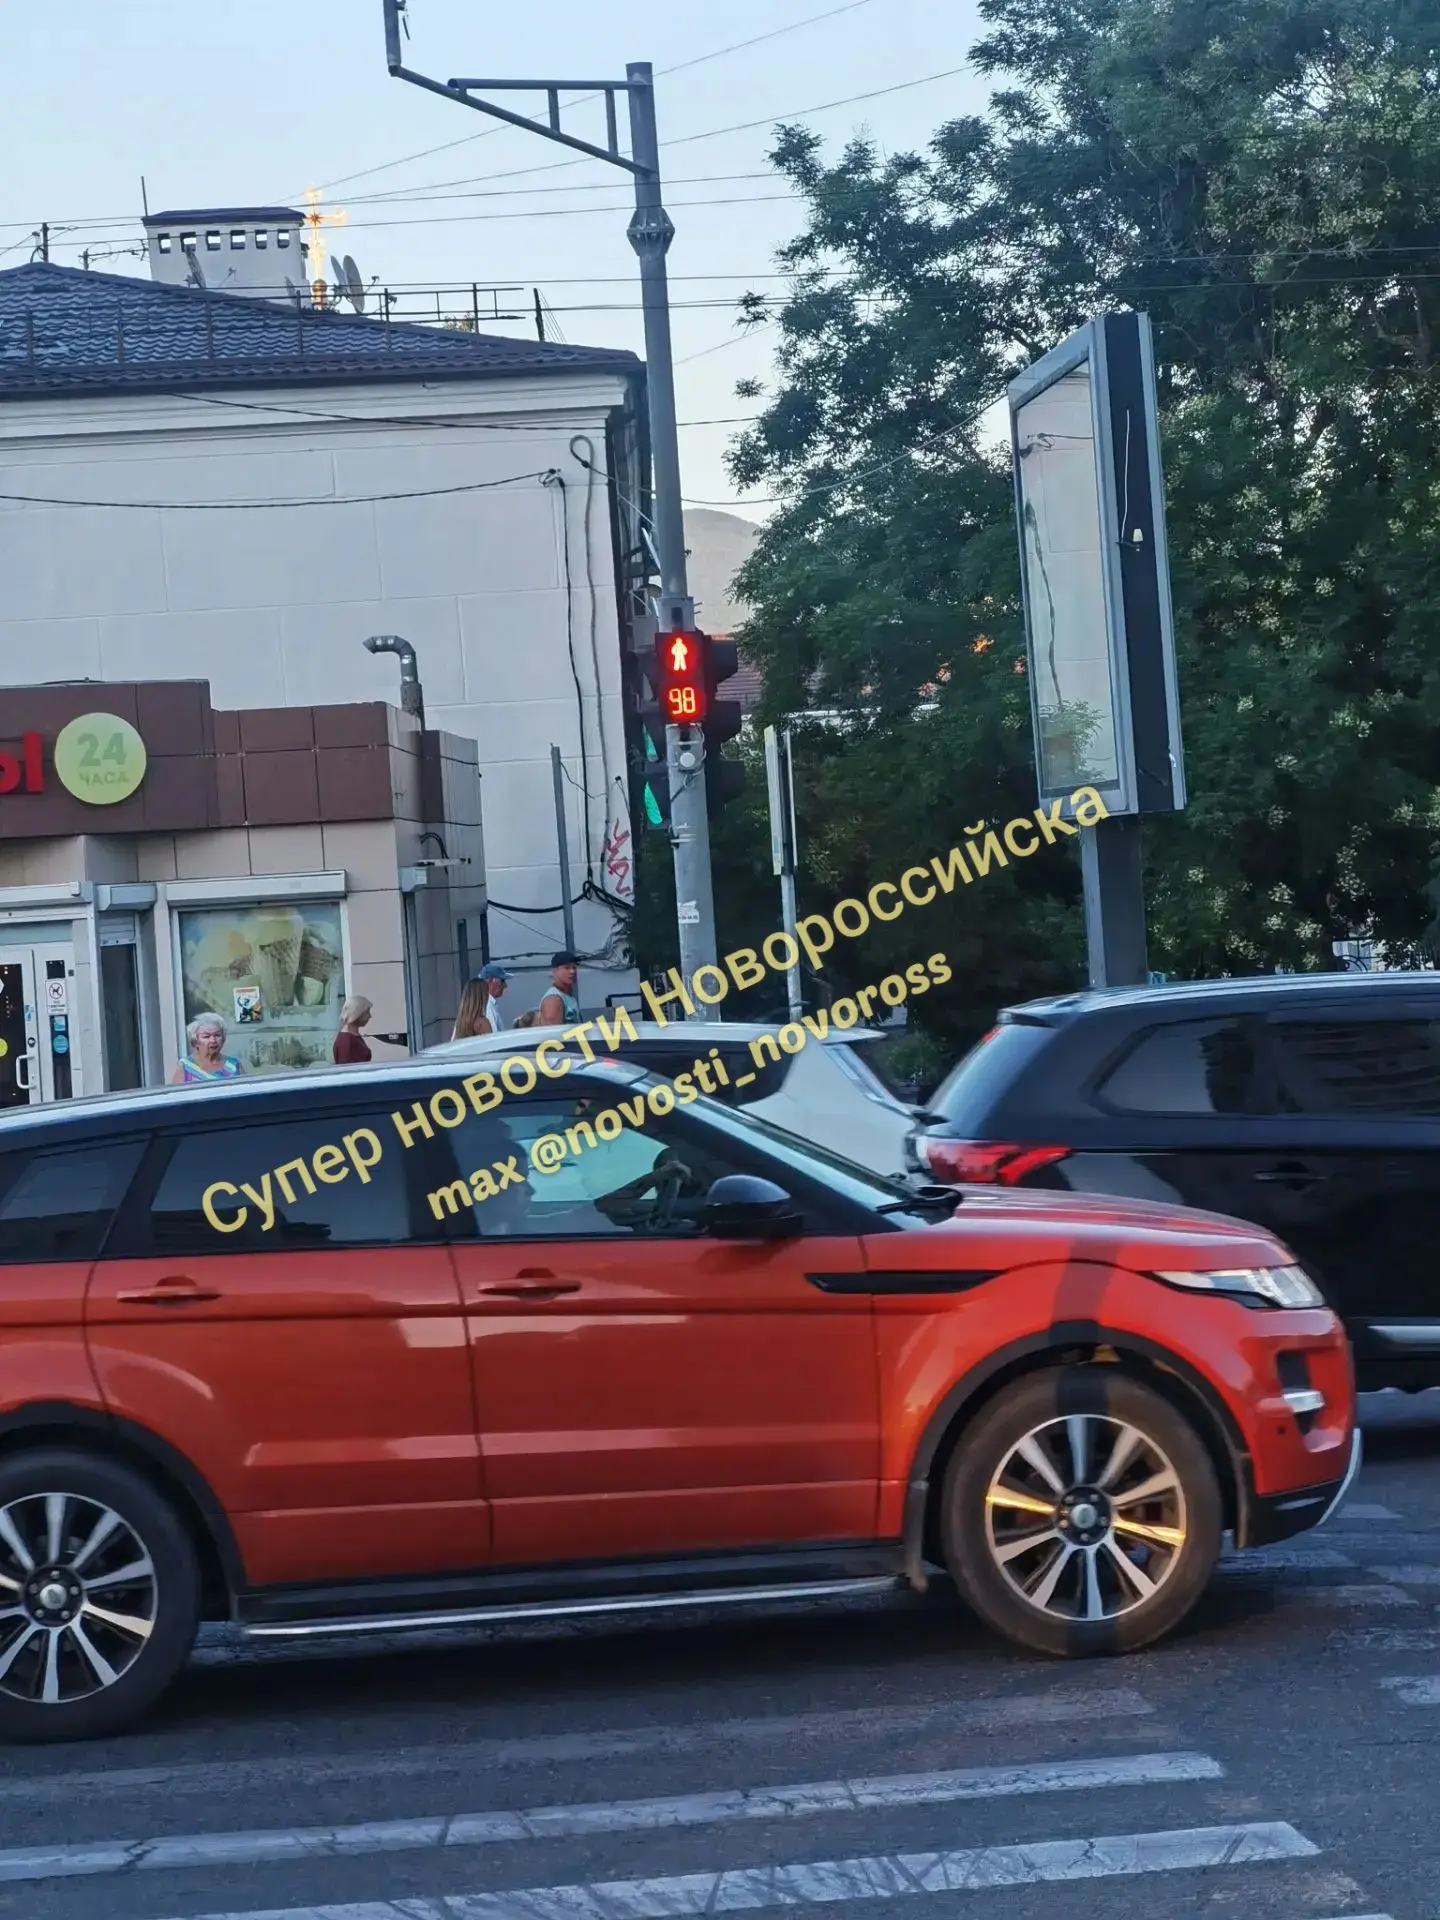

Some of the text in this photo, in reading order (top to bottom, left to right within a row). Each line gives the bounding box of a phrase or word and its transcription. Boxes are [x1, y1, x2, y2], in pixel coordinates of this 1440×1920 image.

[669, 687, 695, 714] 98
[77, 732, 127, 767] 24
[79, 771, 130, 785] ЧАСА
